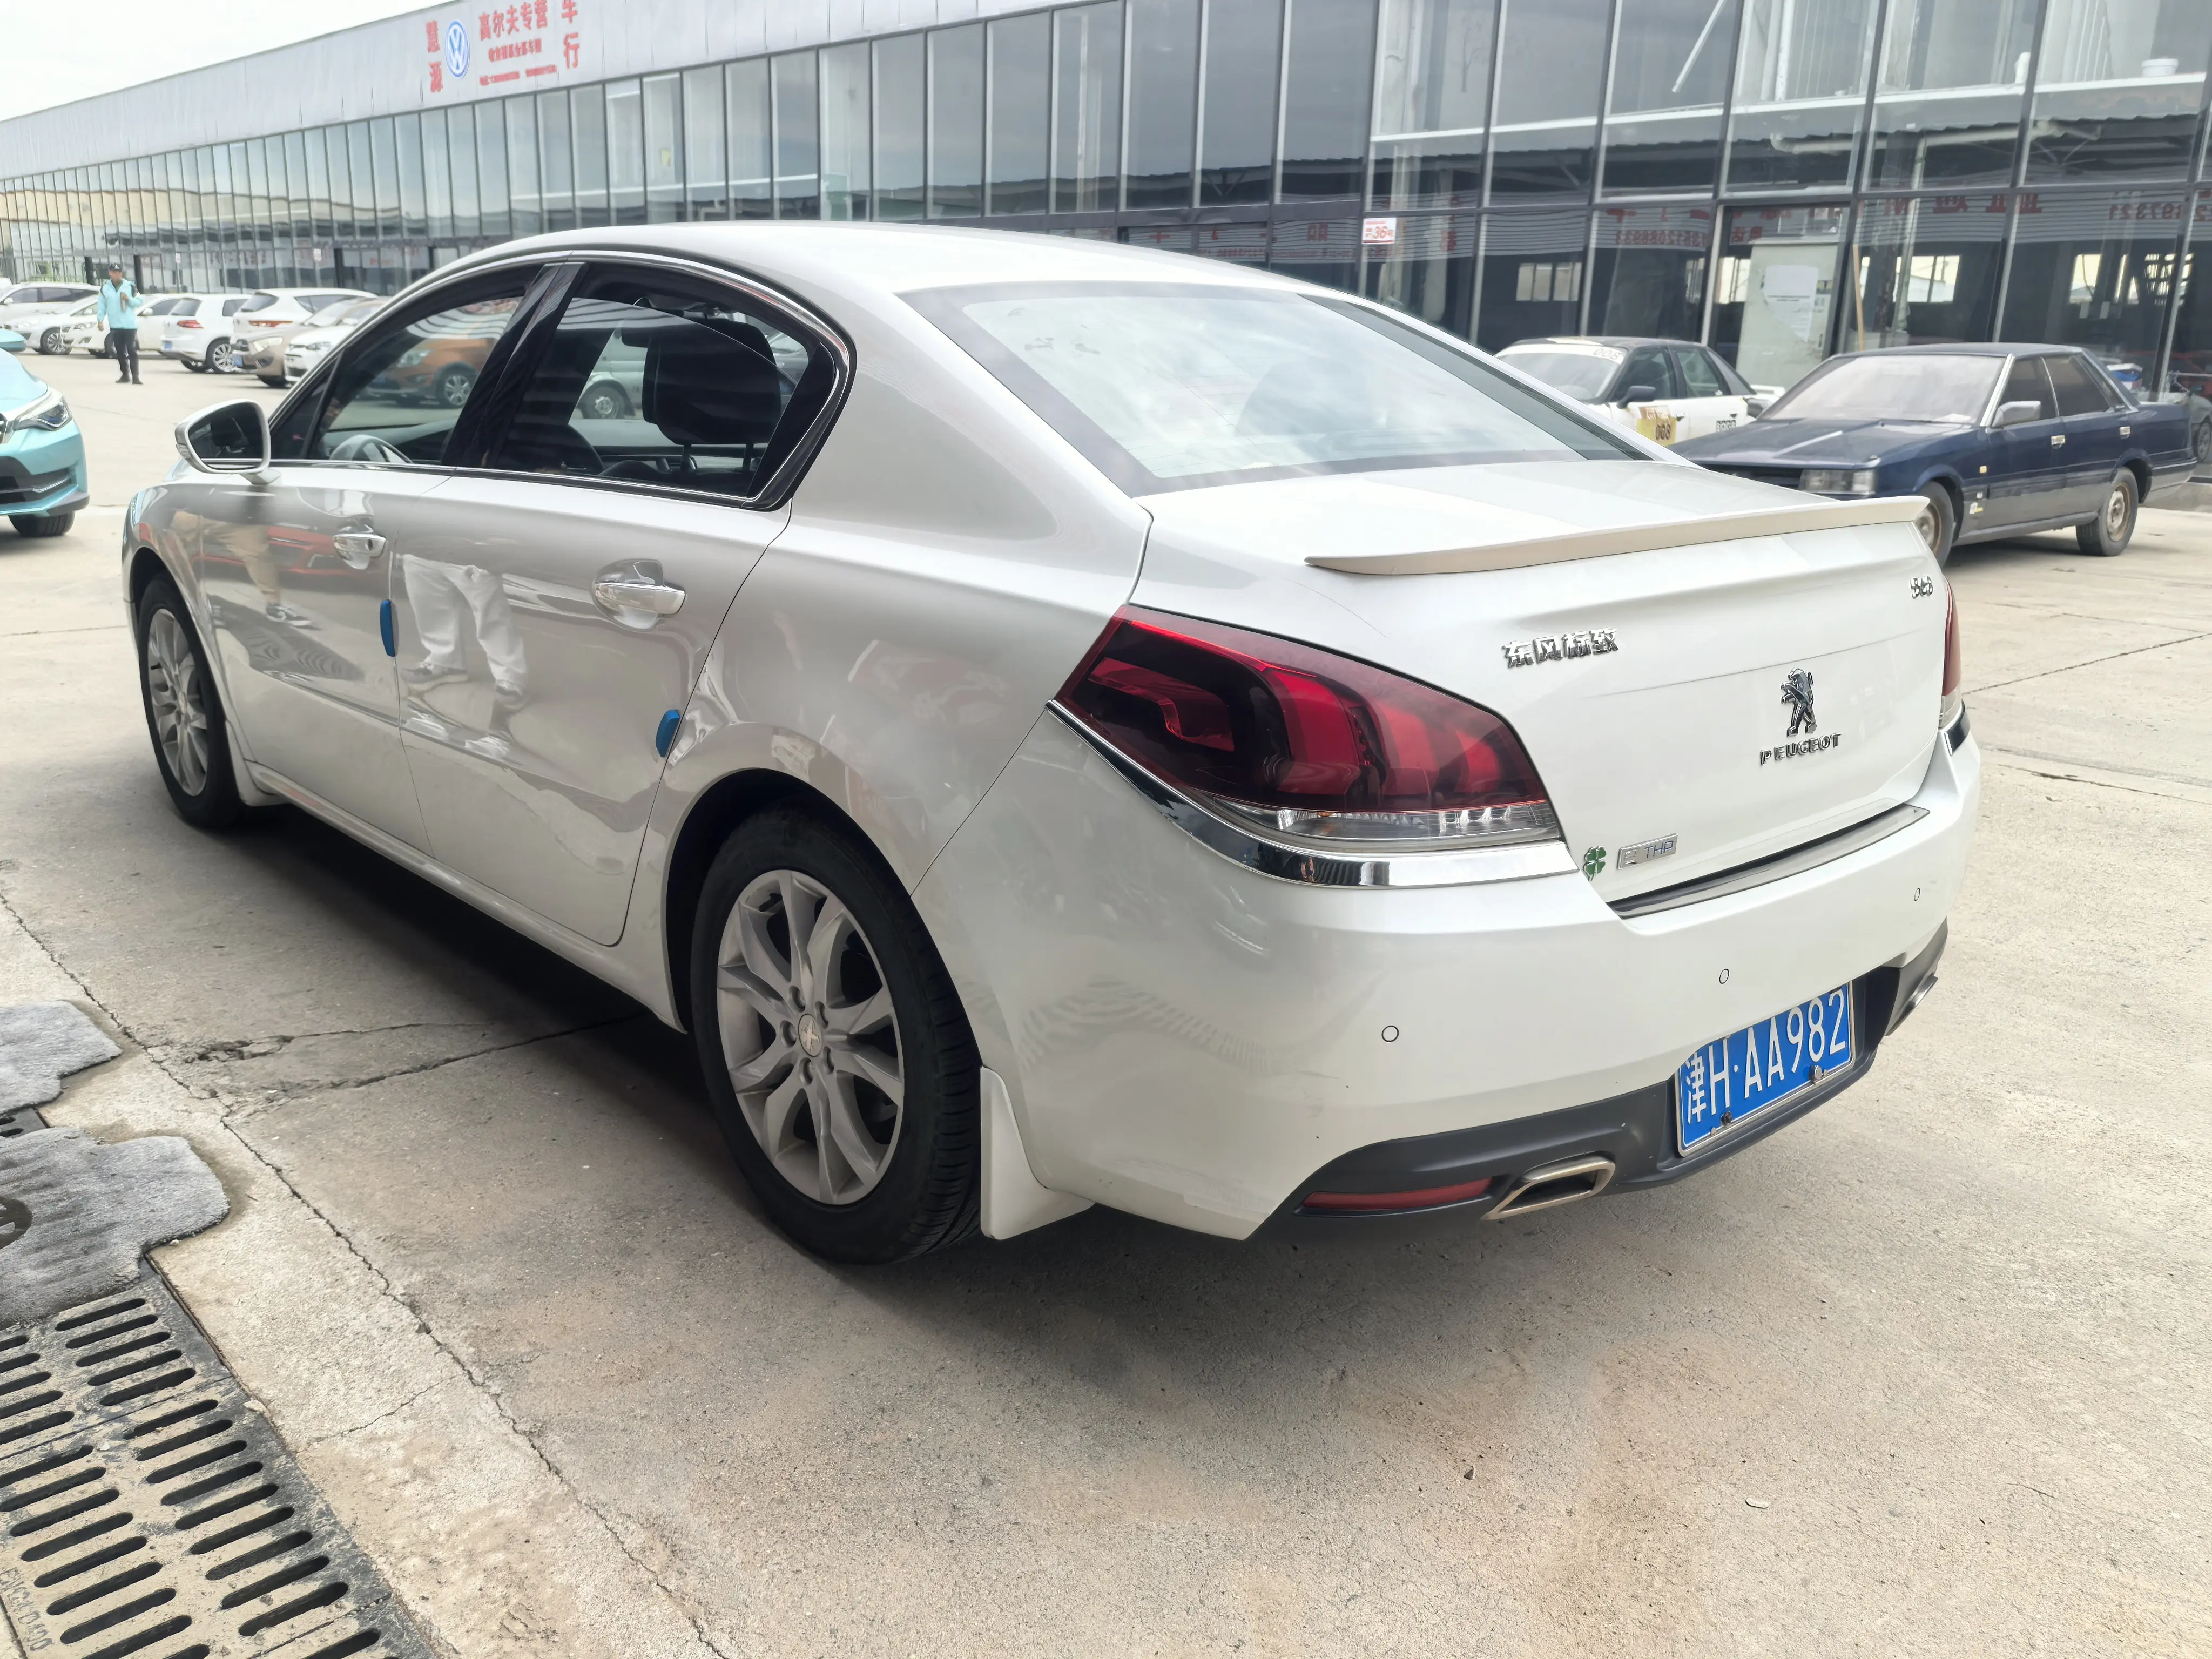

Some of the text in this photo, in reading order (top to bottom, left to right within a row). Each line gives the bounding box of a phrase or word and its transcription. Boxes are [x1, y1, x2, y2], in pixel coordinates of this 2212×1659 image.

[1501, 627, 1619, 668] 东风标致
[1759, 733, 1843, 765] PEUGEOT
[1644, 840, 1674, 858] THP
